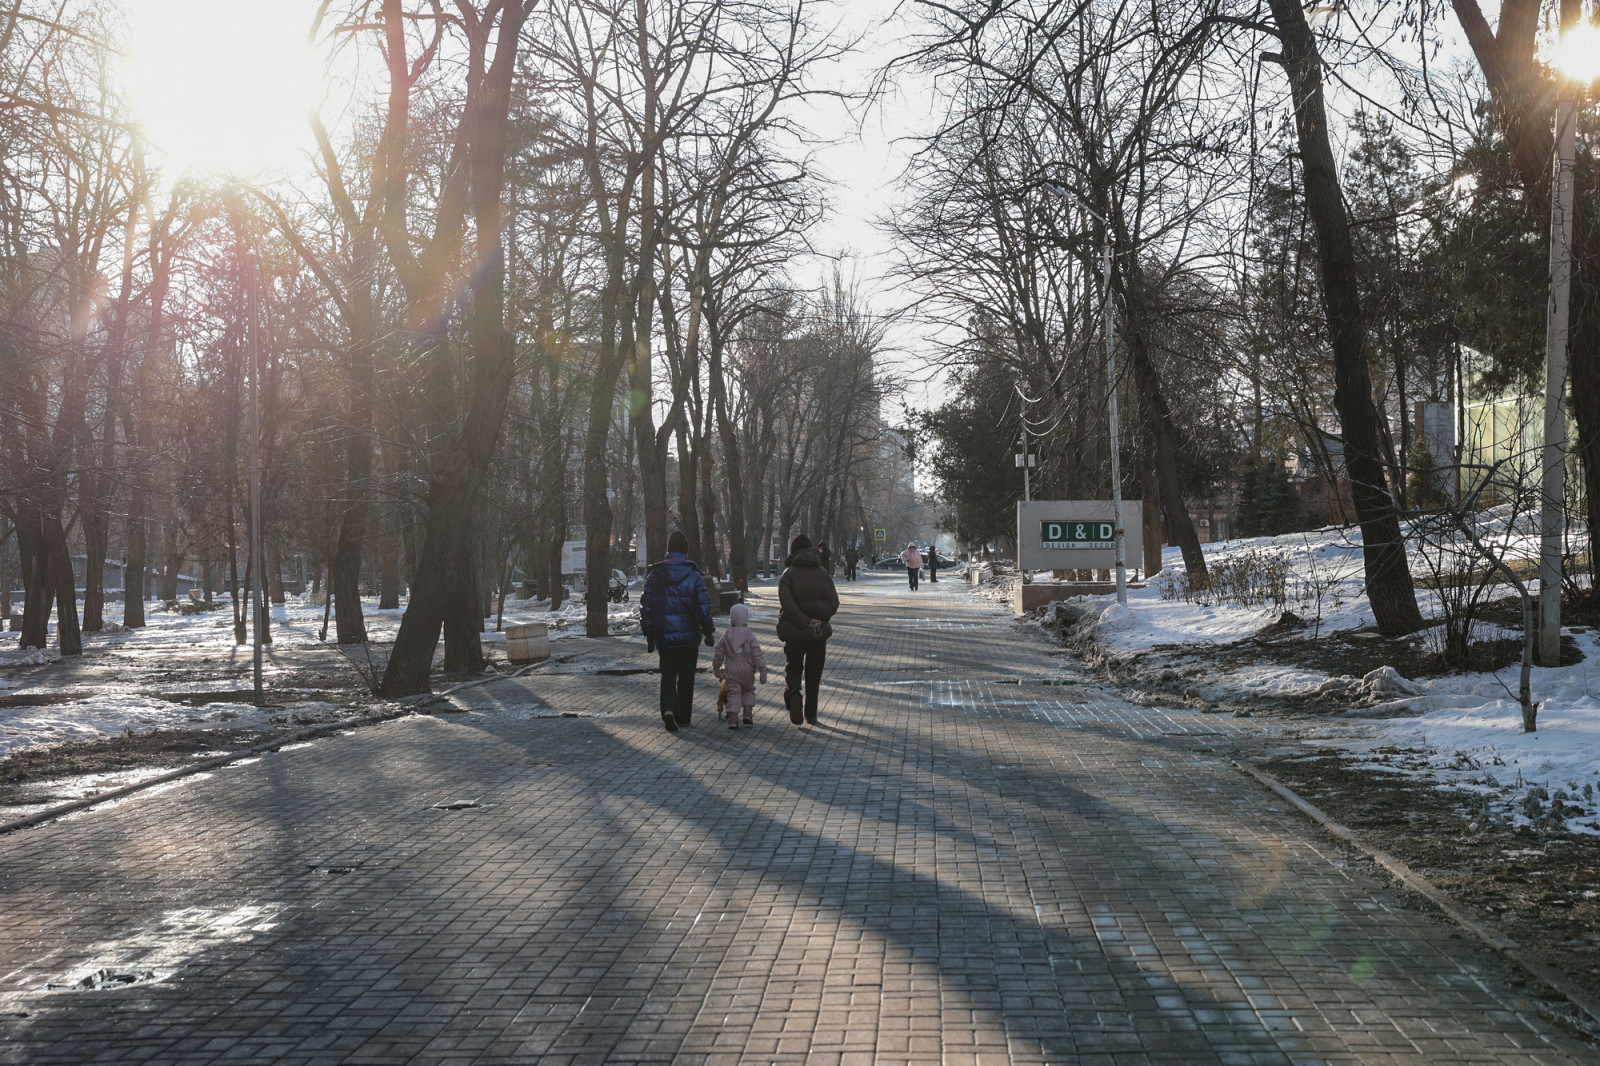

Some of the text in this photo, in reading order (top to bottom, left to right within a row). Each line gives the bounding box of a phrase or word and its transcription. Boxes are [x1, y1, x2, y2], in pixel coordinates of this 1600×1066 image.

[1049, 524, 1113, 539] D & D
